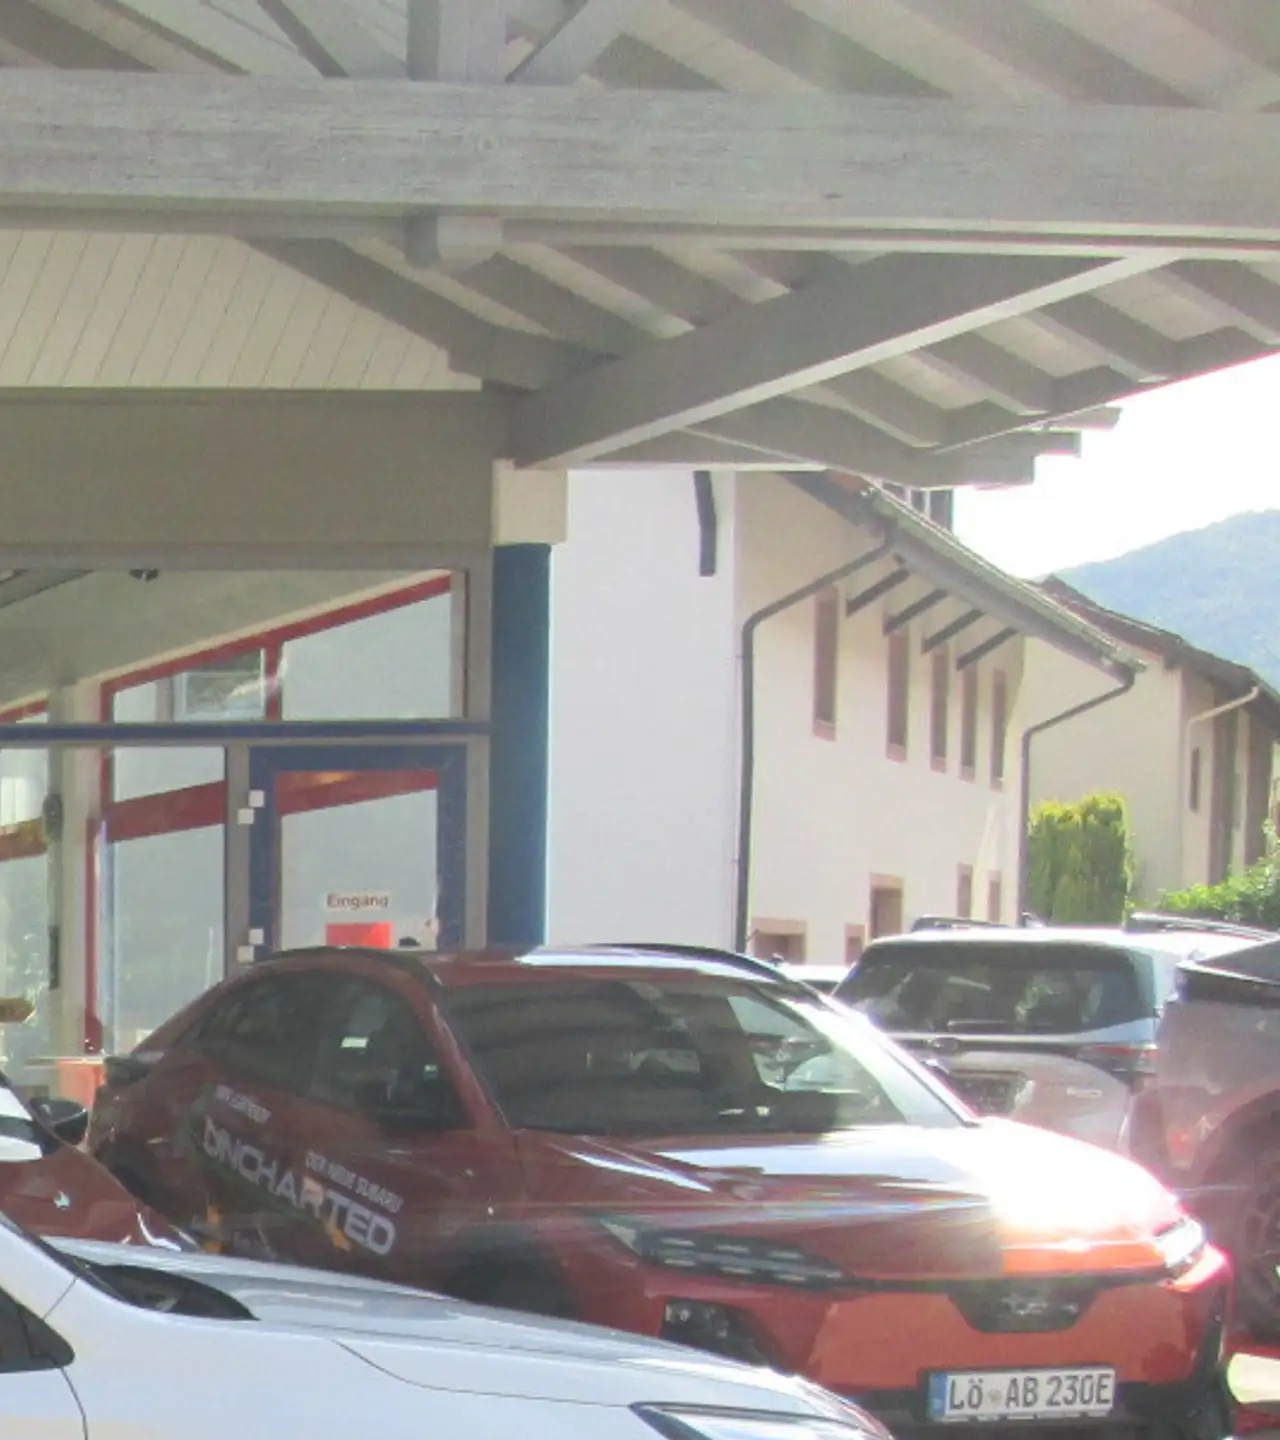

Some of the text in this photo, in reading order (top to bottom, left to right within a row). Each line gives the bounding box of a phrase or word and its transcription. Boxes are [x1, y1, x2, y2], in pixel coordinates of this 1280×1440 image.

[326, 892, 389, 911] Eingang
[203, 1114, 396, 1256] UNCHARTED
[949, 1373, 1112, 1411] LÖ AB 230E
